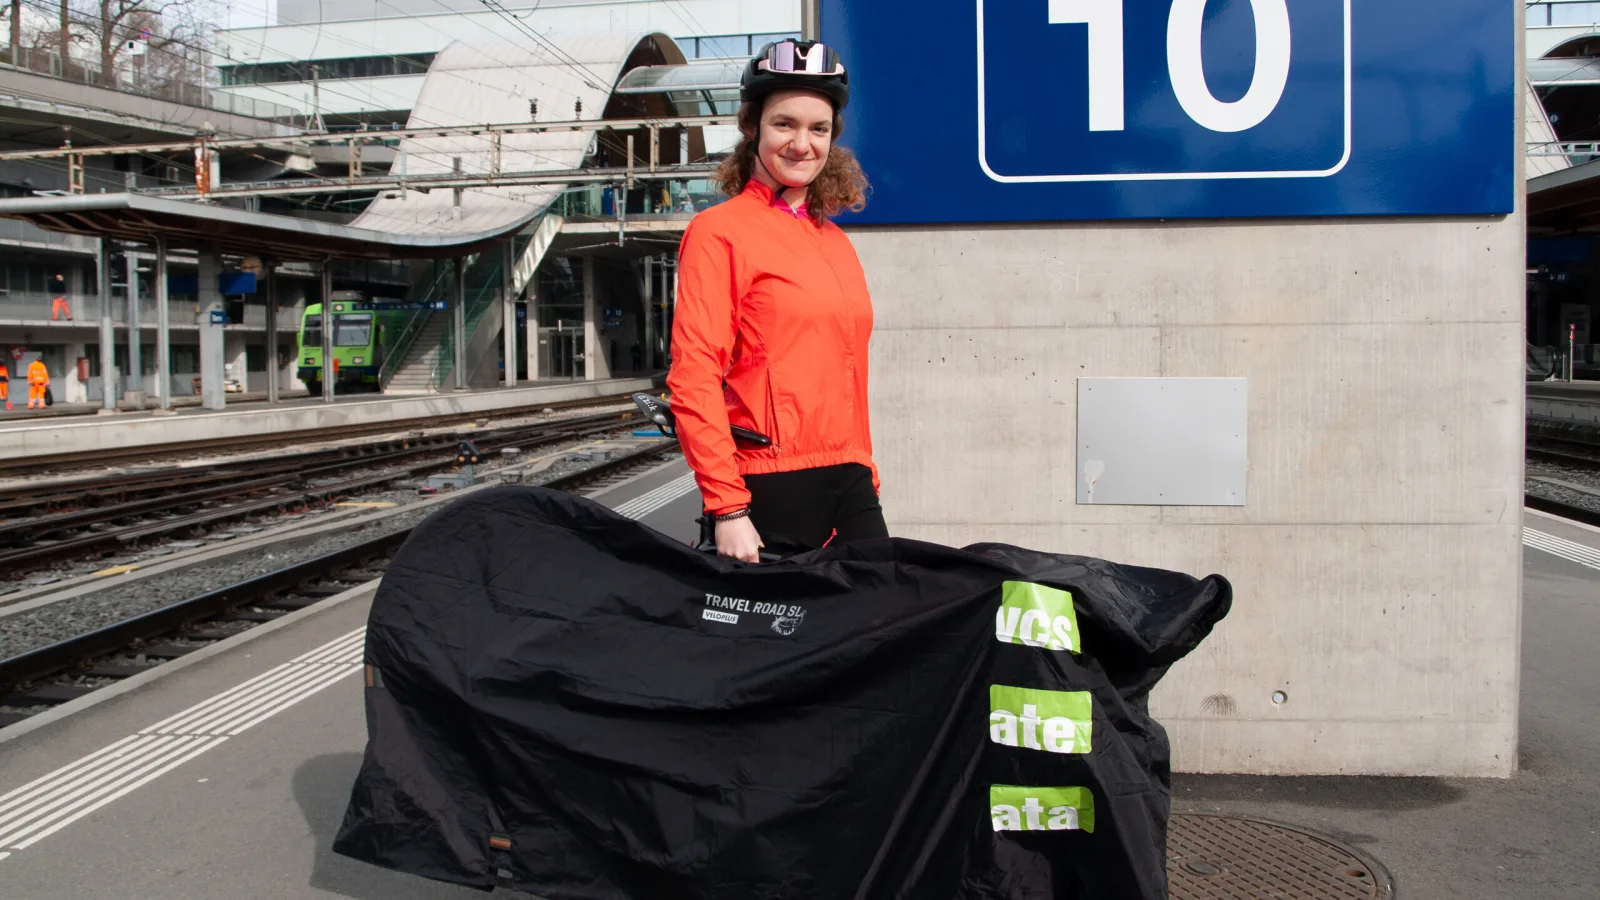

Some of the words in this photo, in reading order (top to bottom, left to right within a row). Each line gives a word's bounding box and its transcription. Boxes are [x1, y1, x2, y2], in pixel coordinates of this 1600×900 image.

[1048, 0, 1292, 133] 10
[705, 593, 750, 612] TRAVEL
[752, 601, 787, 616] ROAD
[787, 605, 802, 617] SL
[705, 611, 736, 623] VELOPLUS
[989, 703, 1076, 754] ate
[990, 797, 1080, 832] ata
